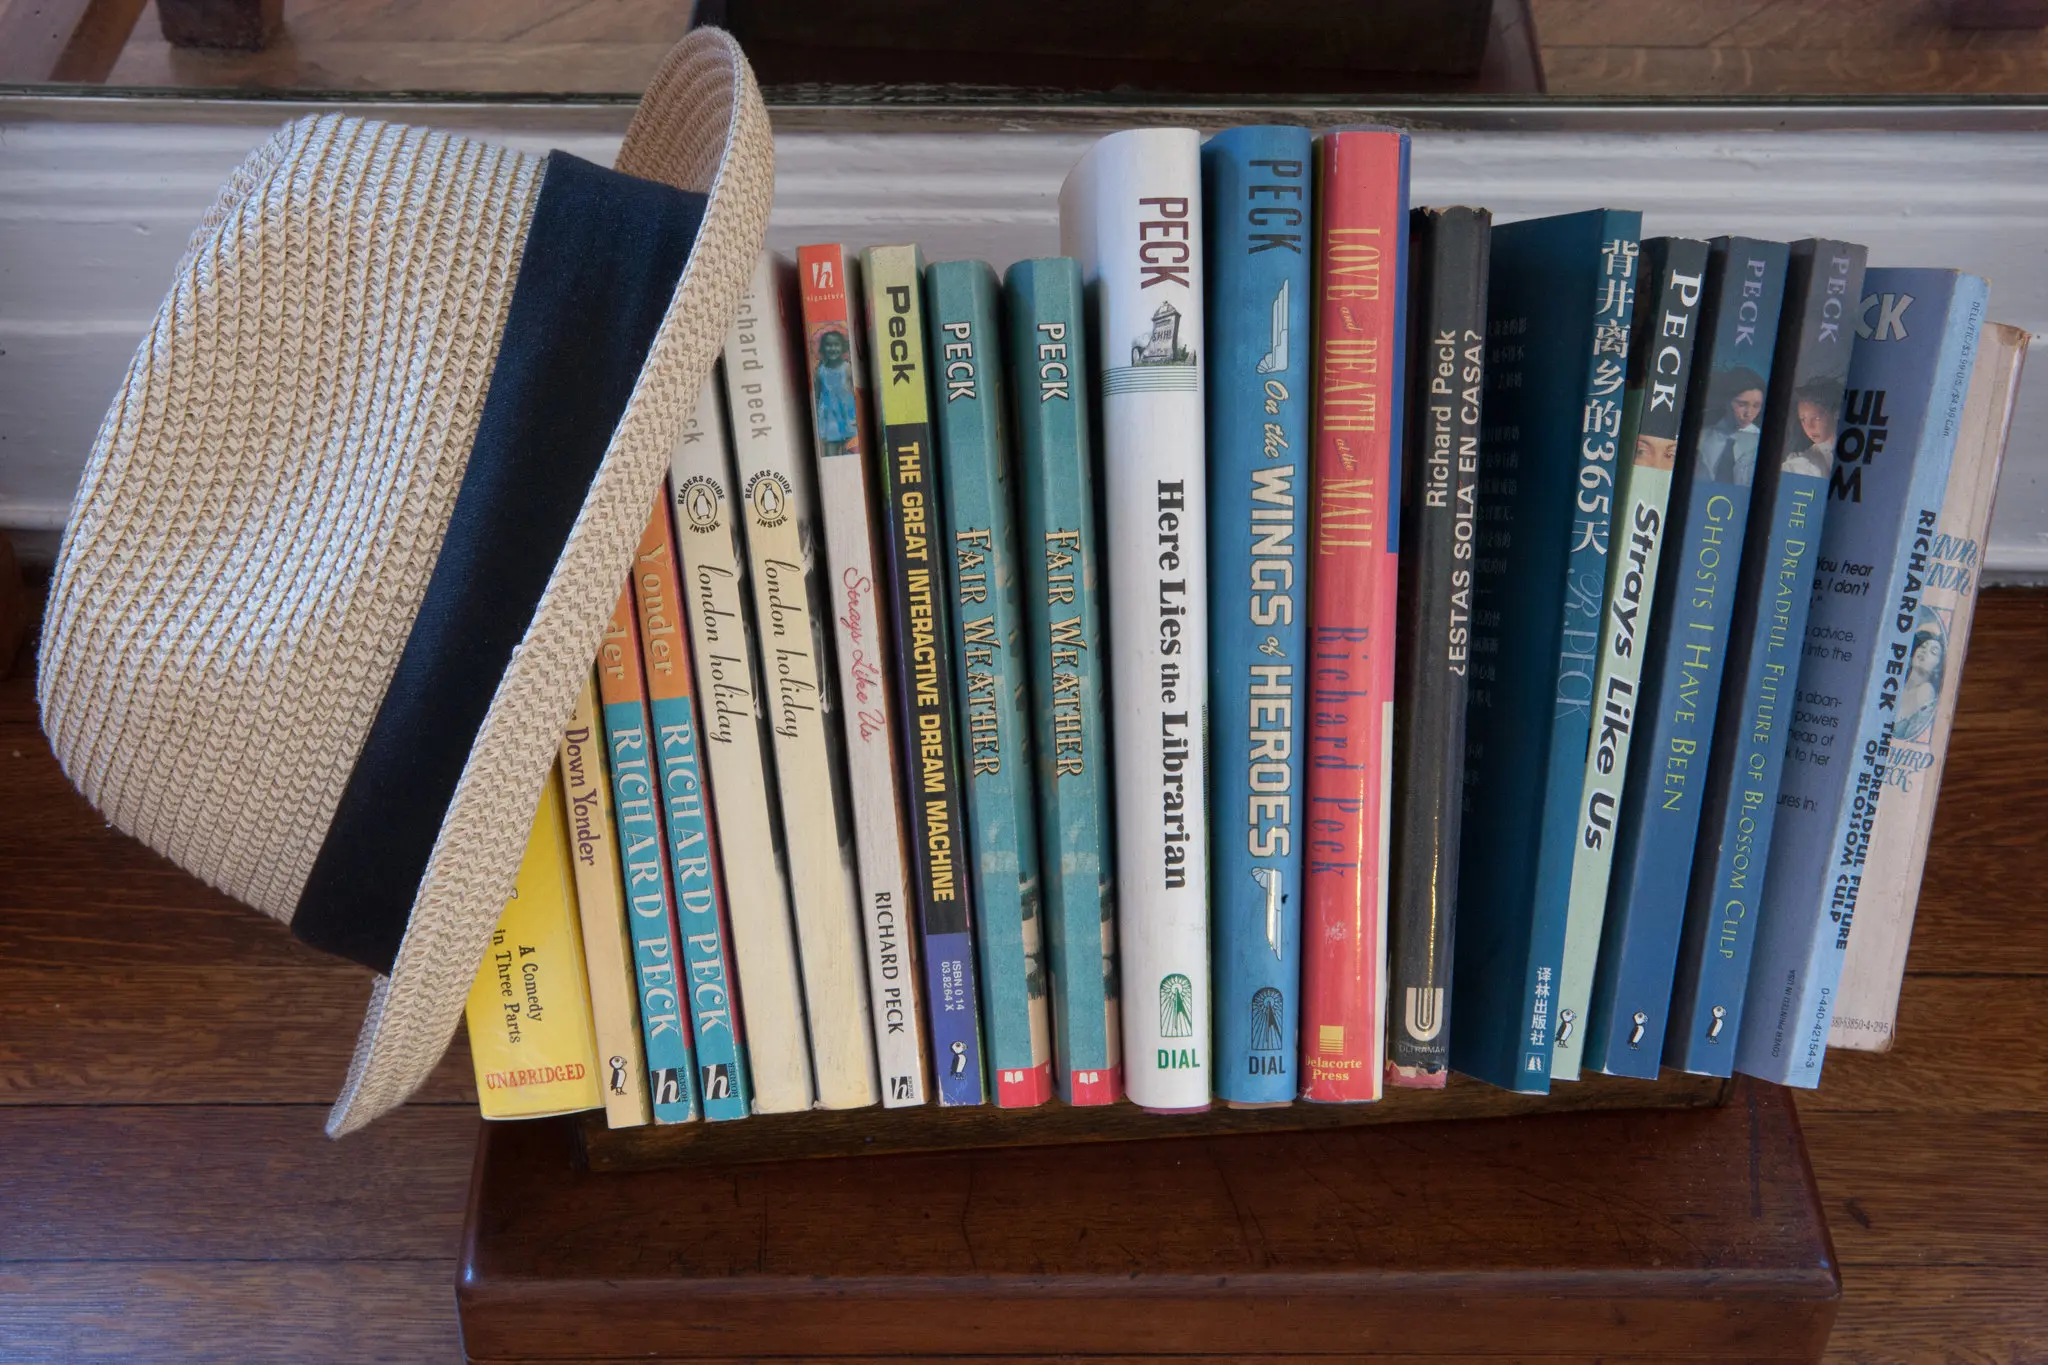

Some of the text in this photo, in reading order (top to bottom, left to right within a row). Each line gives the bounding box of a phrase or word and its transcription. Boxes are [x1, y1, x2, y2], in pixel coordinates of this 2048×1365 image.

[1138, 197, 1190, 290] PECK
[1248, 160, 1303, 255] PECK
[806, 293, 844, 303] signature
[1326, 227, 1381, 301] LOVE
[1735, 256, 1766, 347] PECK
[1818, 255, 1850, 345] PECK
[885, 285, 915, 386] Peck
[1340, 306, 1364, 332] and
[1649, 268, 1702, 413] PECK
[1854, 293, 1916, 341] CK
[737, 290, 771, 439] ichard peck
[943, 321, 976, 404] PECK
[1037, 321, 1069, 404] PECK
[1322, 337, 1378, 433] DEATH
[683, 418, 704, 445] ck
[1426, 329, 1457, 508] Richard Peck
[1836, 427, 1888, 465] OF
[677, 475, 725, 505] READERS GUIDE
[745, 469, 792, 499] READERS GUIDE
[1341, 452, 1359, 471] the
[1449, 329, 1483, 677] ¿ESTAS SOLA EN CASA?
[689, 520, 721, 534] INSIDE
[756, 514, 788, 528] INSIDE
[1319, 476, 1374, 556] MALL
[637, 543, 675, 677] Yonder
[1834, 580, 1869, 596] don't
[1841, 560, 1873, 577] hear
[604, 620, 627, 680] der
[764, 558, 816, 739] london holiday
[1248, 380, 1296, 858] On the WINGS of HEROES
[1808, 642, 1853, 662] into the
[1878, 509, 1937, 712] RICHARD PECK
[697, 563, 749, 745] london holiday
[840, 567, 886, 742] Strays Like Us
[898, 441, 955, 902] THE GREAT INTERACTIVE DREAM MACHINE
[955, 527, 1001, 778] FAIR WEATHER
[1045, 527, 1087, 778] FAIR WEATHER
[1157, 479, 1190, 890] Here Lies the Librarian
[1583, 499, 1661, 853] Strays Like Us
[1662, 495, 1734, 812] GHOSTS I HAVE BEEN
[1719, 488, 1815, 960] THE DREADFUL FUTURE OF BLOSSOM CULP
[1795, 711, 1839, 728] powers
[1805, 691, 1842, 708] aban-
[1820, 734, 1834, 747] of
[1311, 626, 1368, 878] Richard Peck
[1795, 748, 1807, 760] to
[1810, 750, 1830, 766] her
[565, 726, 601, 866] Down Yonder
[1803, 796, 1818, 812] in:
[1829, 740, 1878, 923] OF BLOSSOM CULP
[1835, 721, 1895, 950] THE DREADFUL FUTURE
[611, 723, 680, 1040] RICHARD PECK
[660, 719, 730, 1035] RICHARD PECK
[493, 929, 521, 1043] in Three Parts
[519, 945, 544, 1021] A Comedy
[874, 891, 904, 1035] RICHARD PECK
[952, 960, 965, 1010] ISBN 0 14
[945, 1004, 955, 1012] X
[1530, 965, 1552, 1046] 译林出版社
[1771, 969, 1796, 1058] COVER PRINTED IN USA
[1805, 987, 1830, 1068] 0-440-42154-3
[485, 1063, 586, 1090] UNABRIDGED
[678, 1066, 688, 1104] HODDER
[728, 1062, 739, 1098] HODDER
[1157, 1048, 1201, 1069] DIAL
[1248, 1055, 1287, 1075] DIAL
[1305, 1055, 1362, 1081] Delacorte Press
